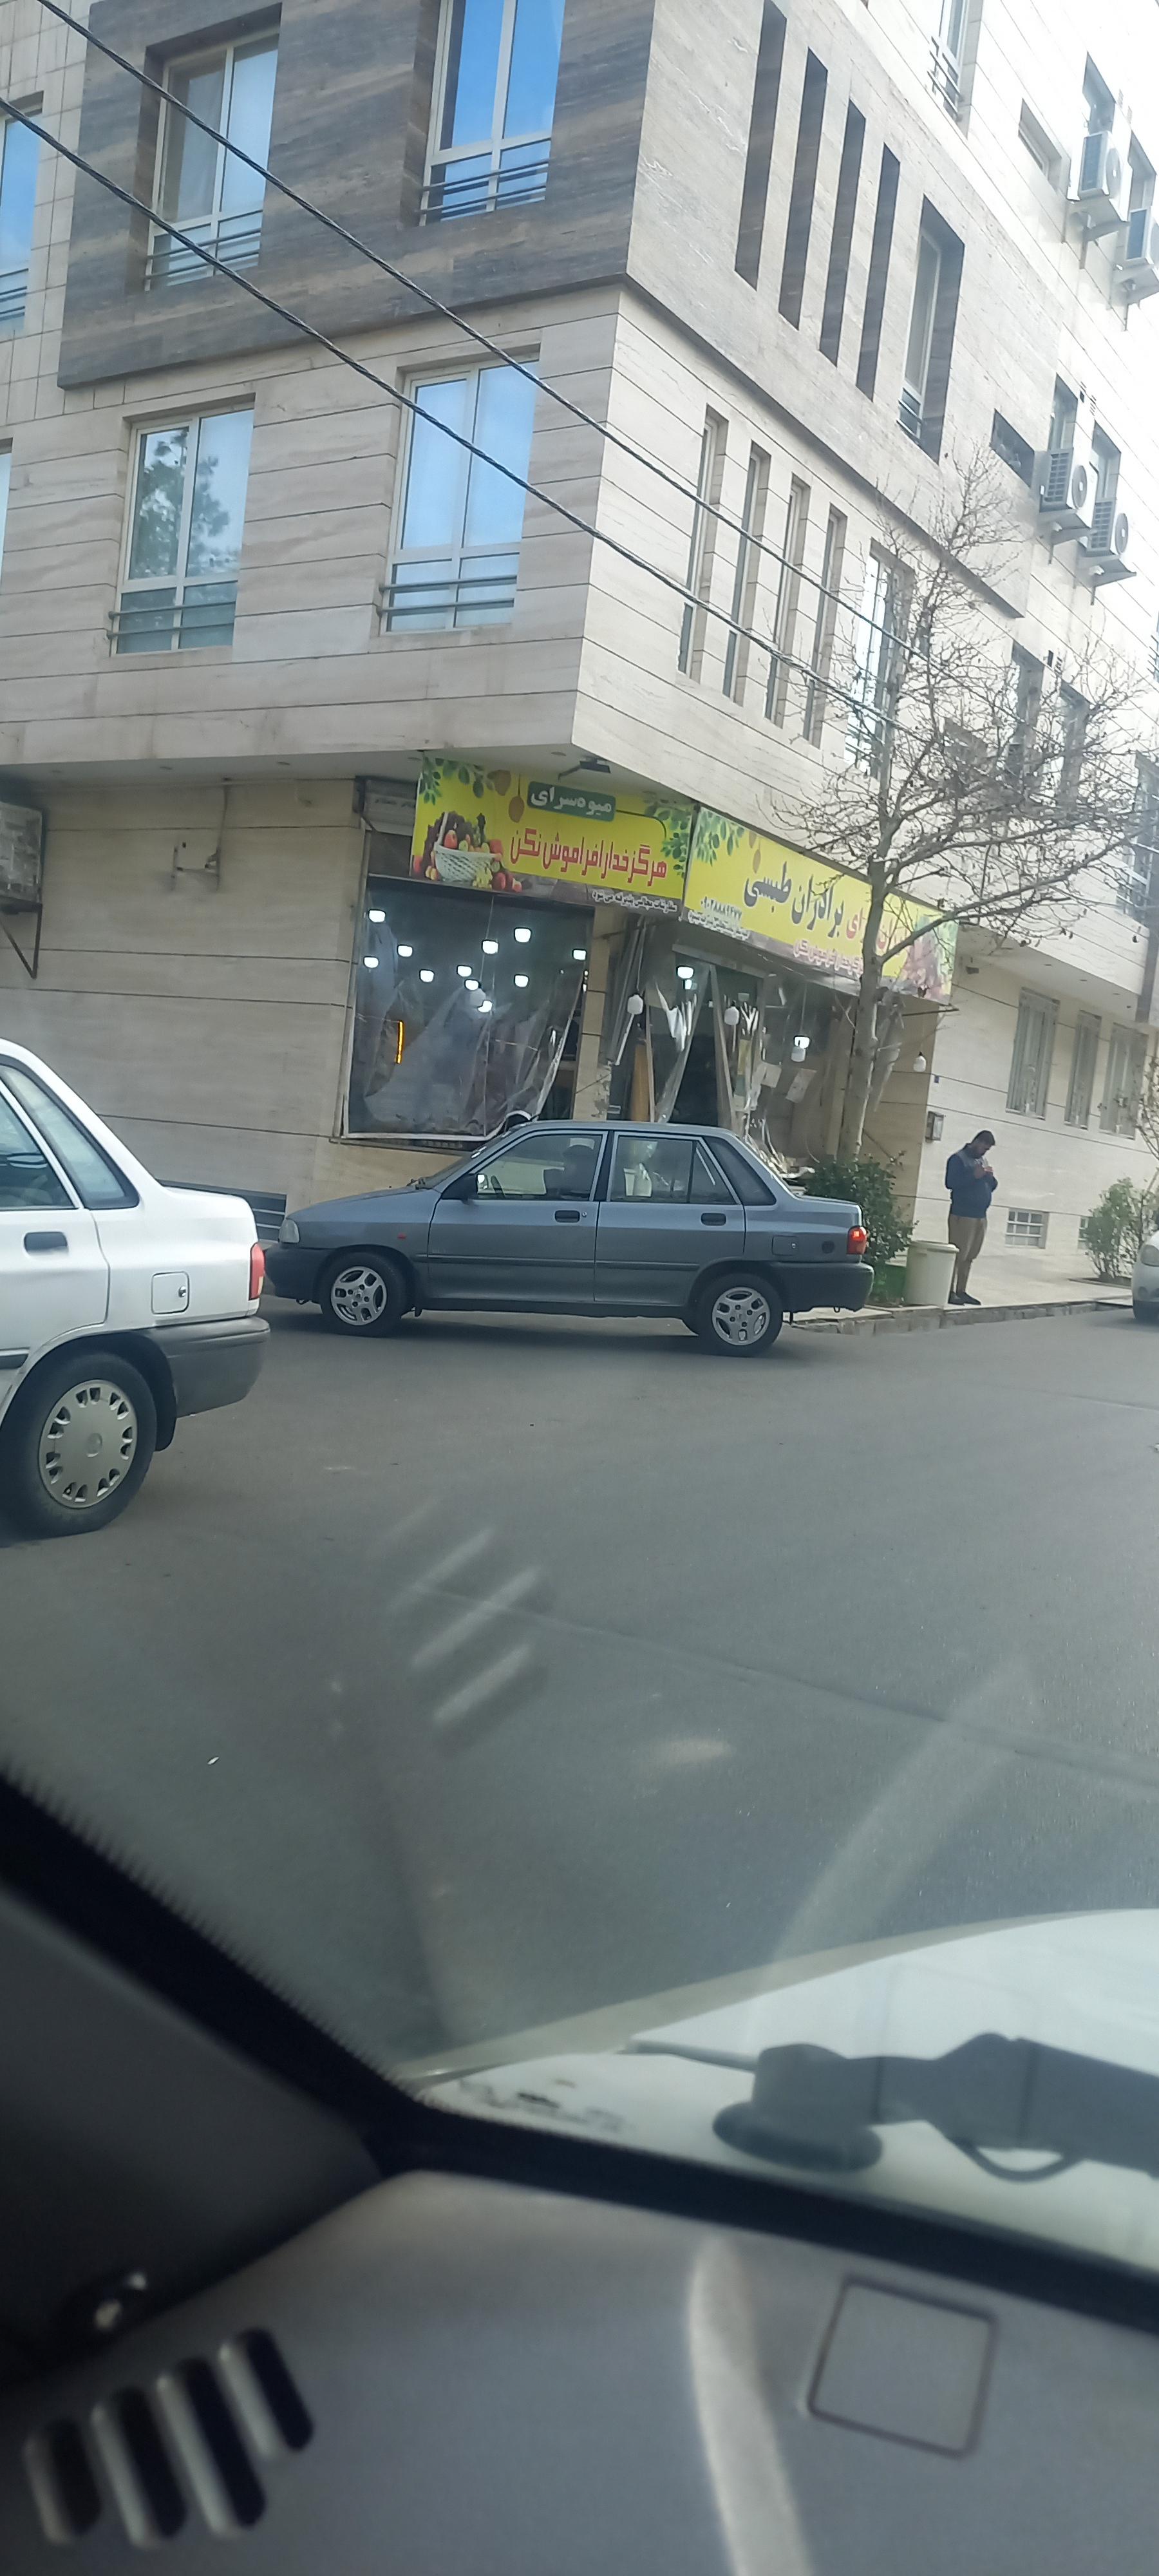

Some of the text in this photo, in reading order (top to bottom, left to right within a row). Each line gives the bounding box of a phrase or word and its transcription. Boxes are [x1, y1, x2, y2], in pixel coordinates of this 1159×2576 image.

[531, 786, 612, 815] میوه سرای
[510, 828, 541, 864] نکن
[542, 831, 599, 876] فراموش
[608, 840, 629, 872] خدا
[627, 844, 667, 887] هرگز
[744, 860, 792, 913] طبسی
[791, 873, 844, 938] برادران
